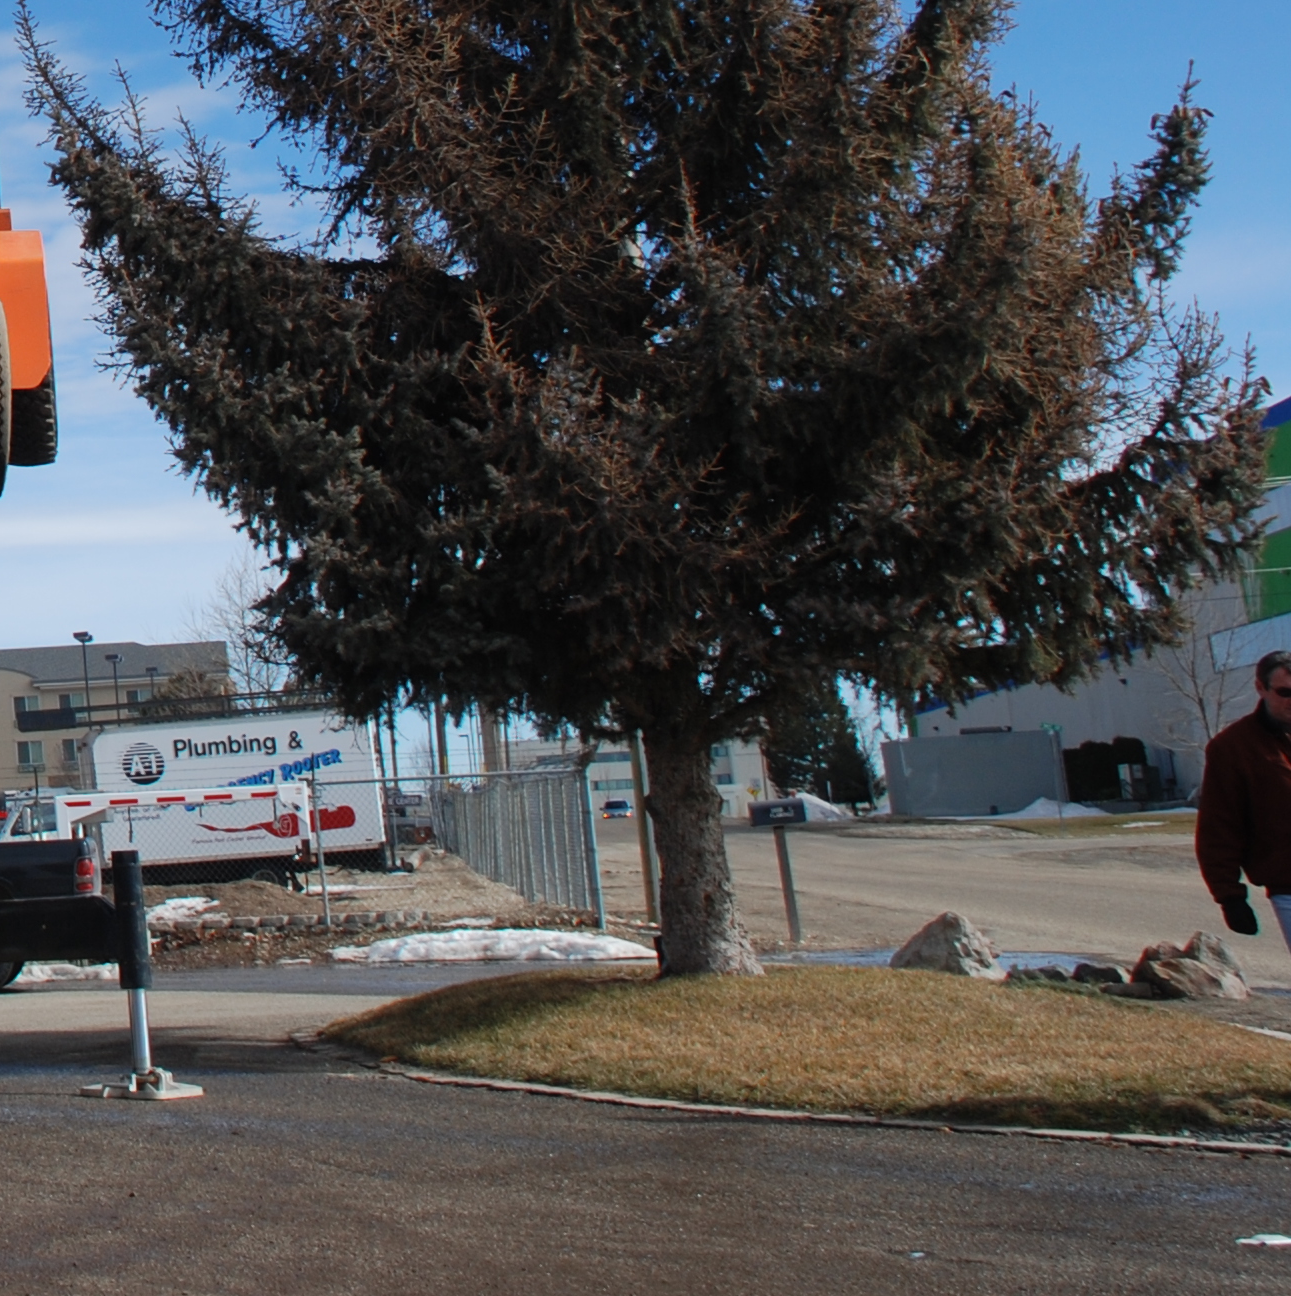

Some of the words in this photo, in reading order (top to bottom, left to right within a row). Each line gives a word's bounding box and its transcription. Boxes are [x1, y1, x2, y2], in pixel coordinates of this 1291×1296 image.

[173, 734, 277, 759] Plumbing
[288, 730, 303, 750] &
[279, 748, 343, 781] ROOTER
